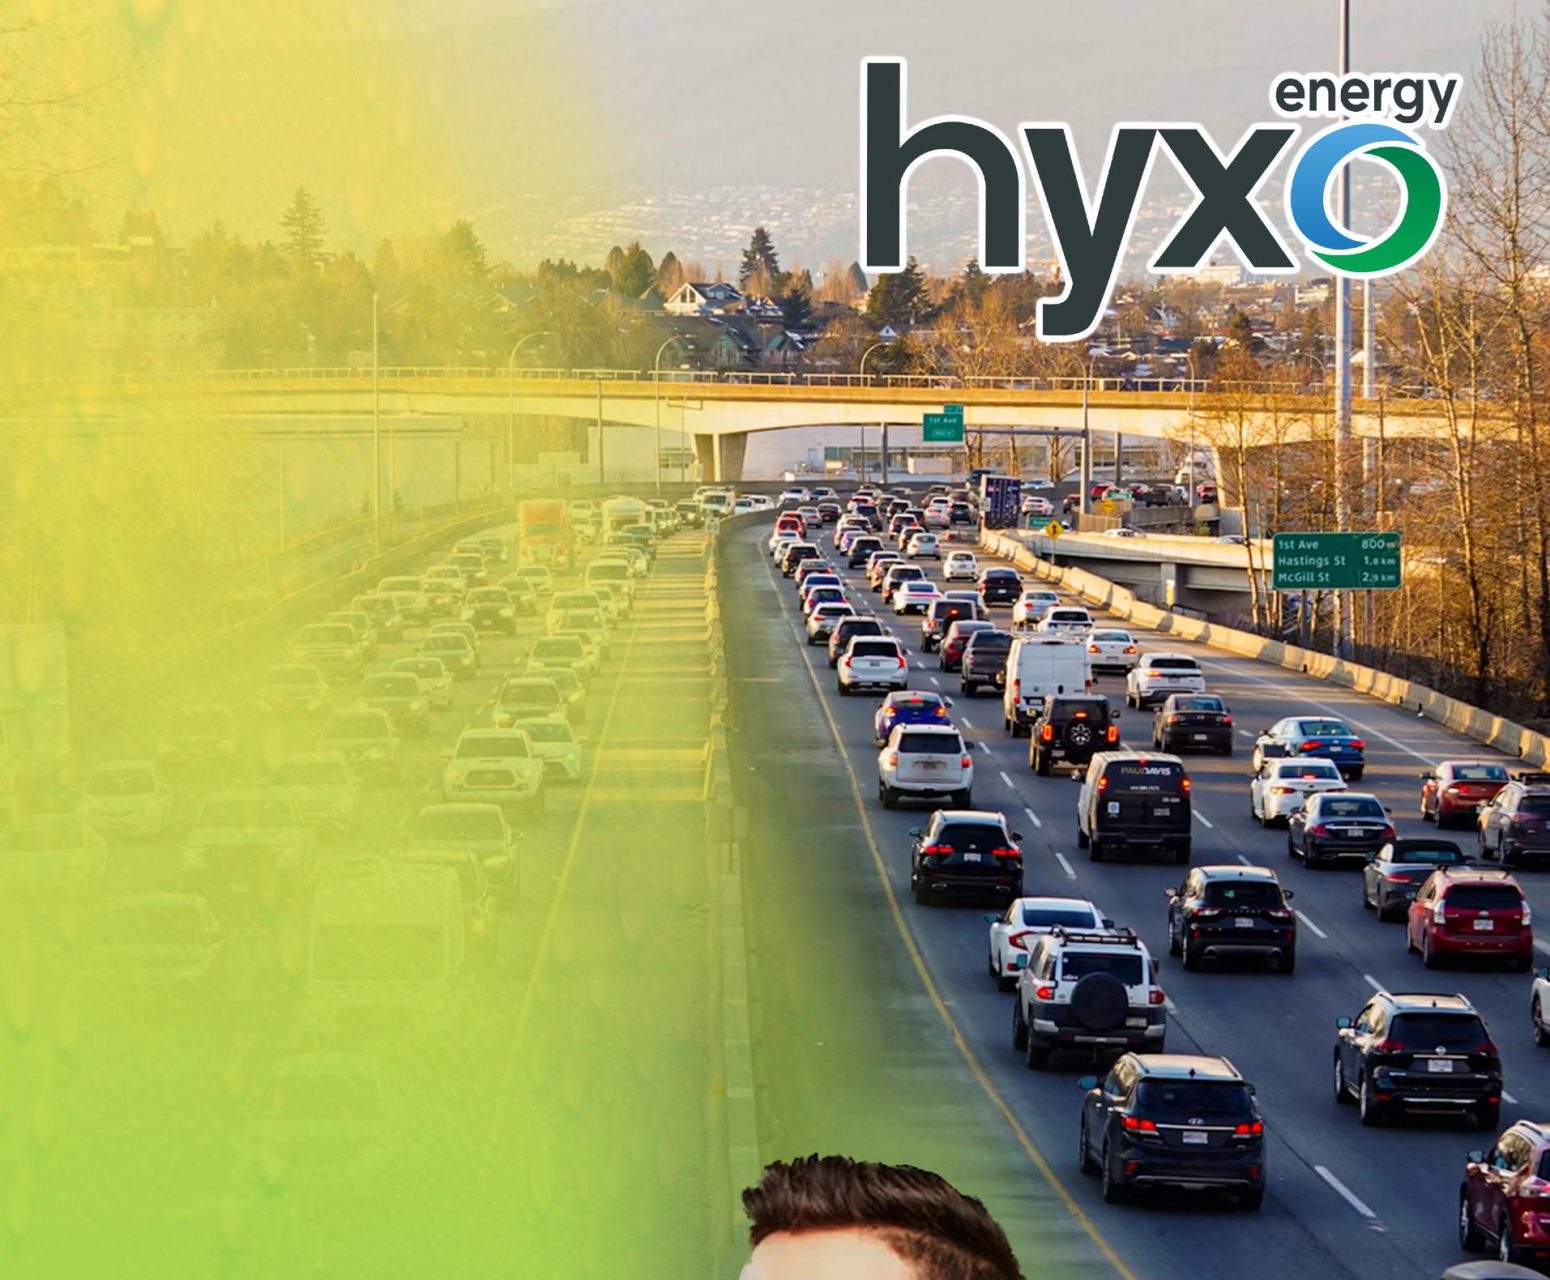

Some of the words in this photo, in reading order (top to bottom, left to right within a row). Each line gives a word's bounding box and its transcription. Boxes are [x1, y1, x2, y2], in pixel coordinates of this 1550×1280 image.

[1278, 539, 1295, 550] 1st
[1298, 539, 1319, 550] Ave
[1361, 539, 1385, 549] 800
[1278, 555, 1330, 568] Hastings
[1334, 555, 1346, 566] St
[1364, 556, 1379, 566] 1.8
[1381, 557, 1396, 566] km
[1278, 572, 1315, 582] McGill
[1318, 572, 1330, 582] St
[1362, 572, 1379, 582] 2.9
[1381, 573, 1396, 582] km
